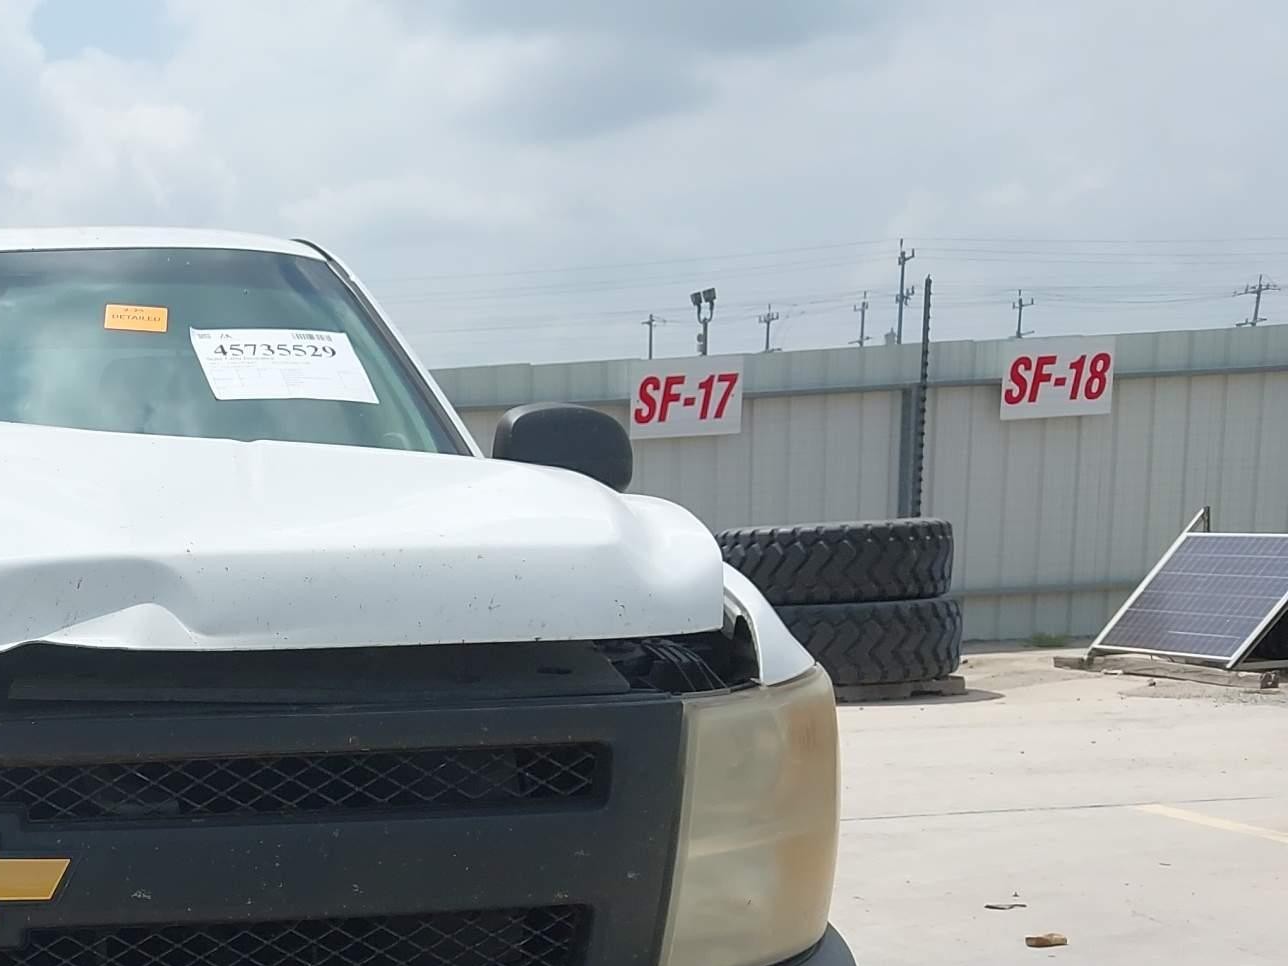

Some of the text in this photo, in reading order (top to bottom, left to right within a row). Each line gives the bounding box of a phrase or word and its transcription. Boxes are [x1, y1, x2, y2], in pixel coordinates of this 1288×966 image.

[213, 342, 337, 359] 45735529
[634, 372, 738, 425] SF-17
[1003, 352, 1111, 406] SF-18
